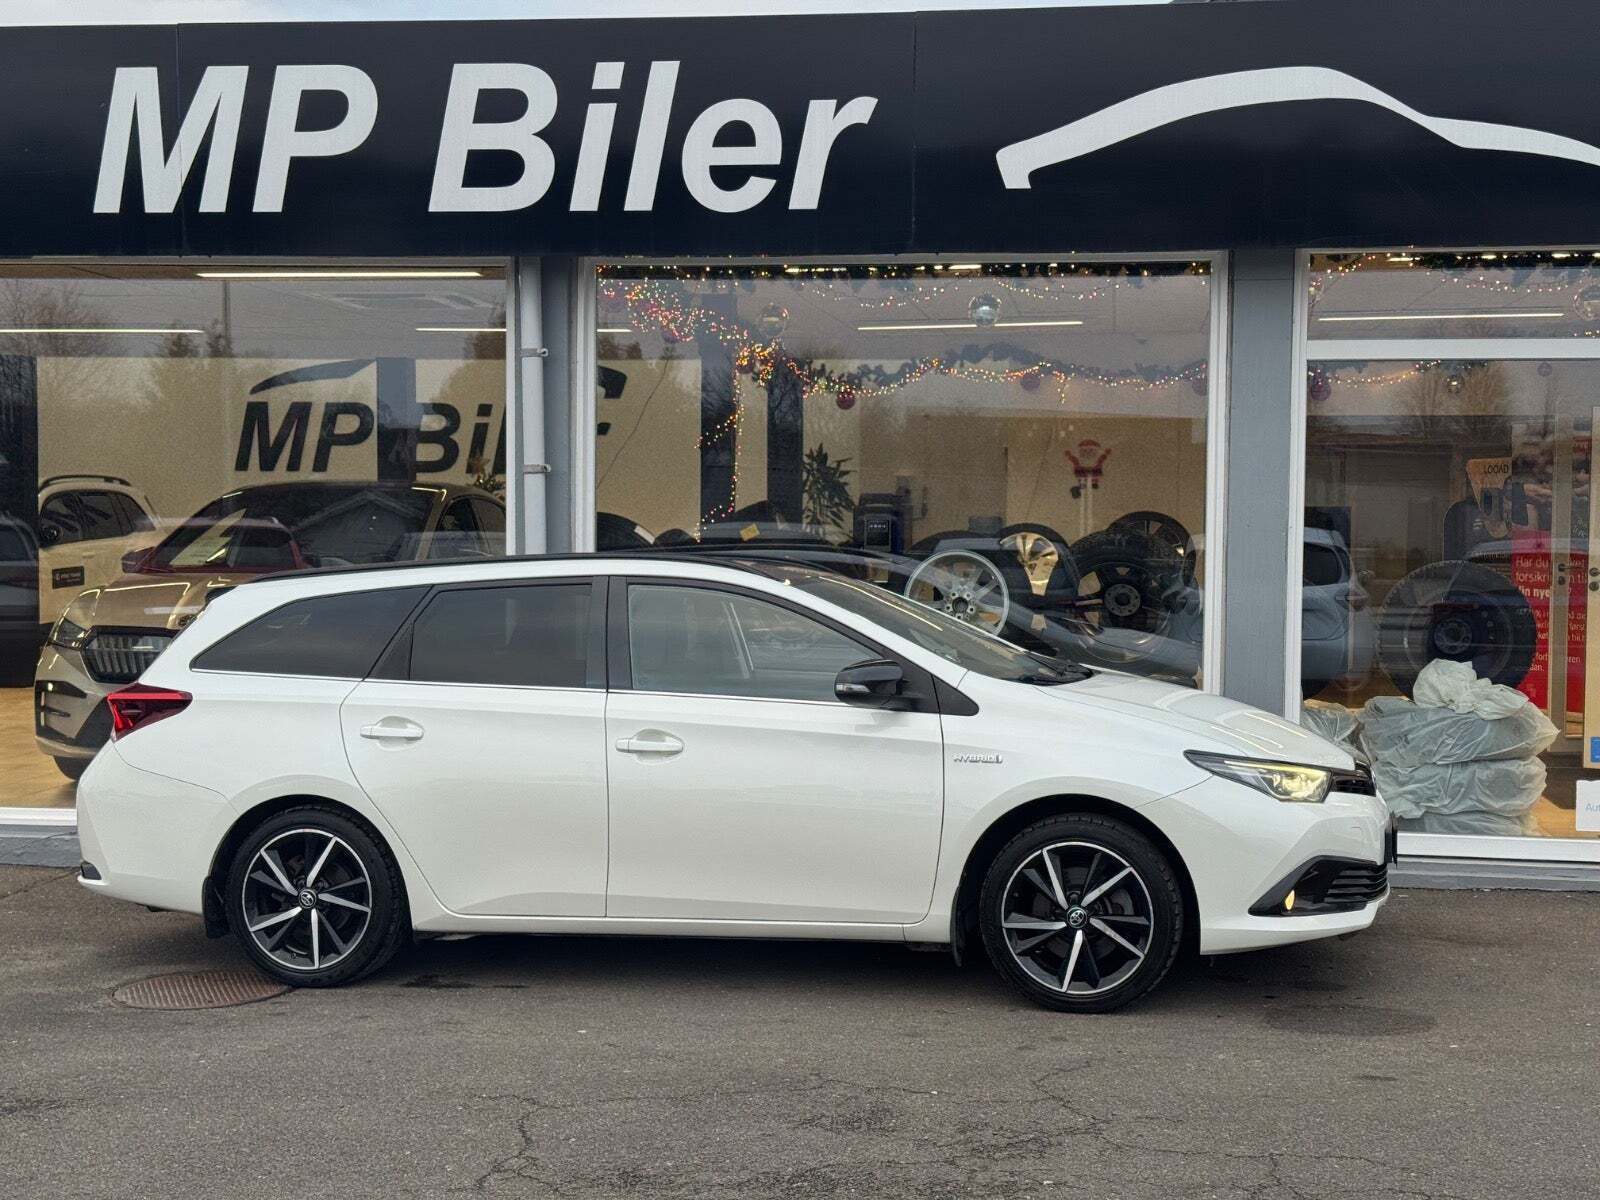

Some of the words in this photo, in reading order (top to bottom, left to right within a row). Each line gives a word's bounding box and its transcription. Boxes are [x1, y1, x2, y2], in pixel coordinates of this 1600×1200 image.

[93, 64, 379, 214] MP
[428, 60, 879, 213] Biler
[235, 401, 375, 472] MP
